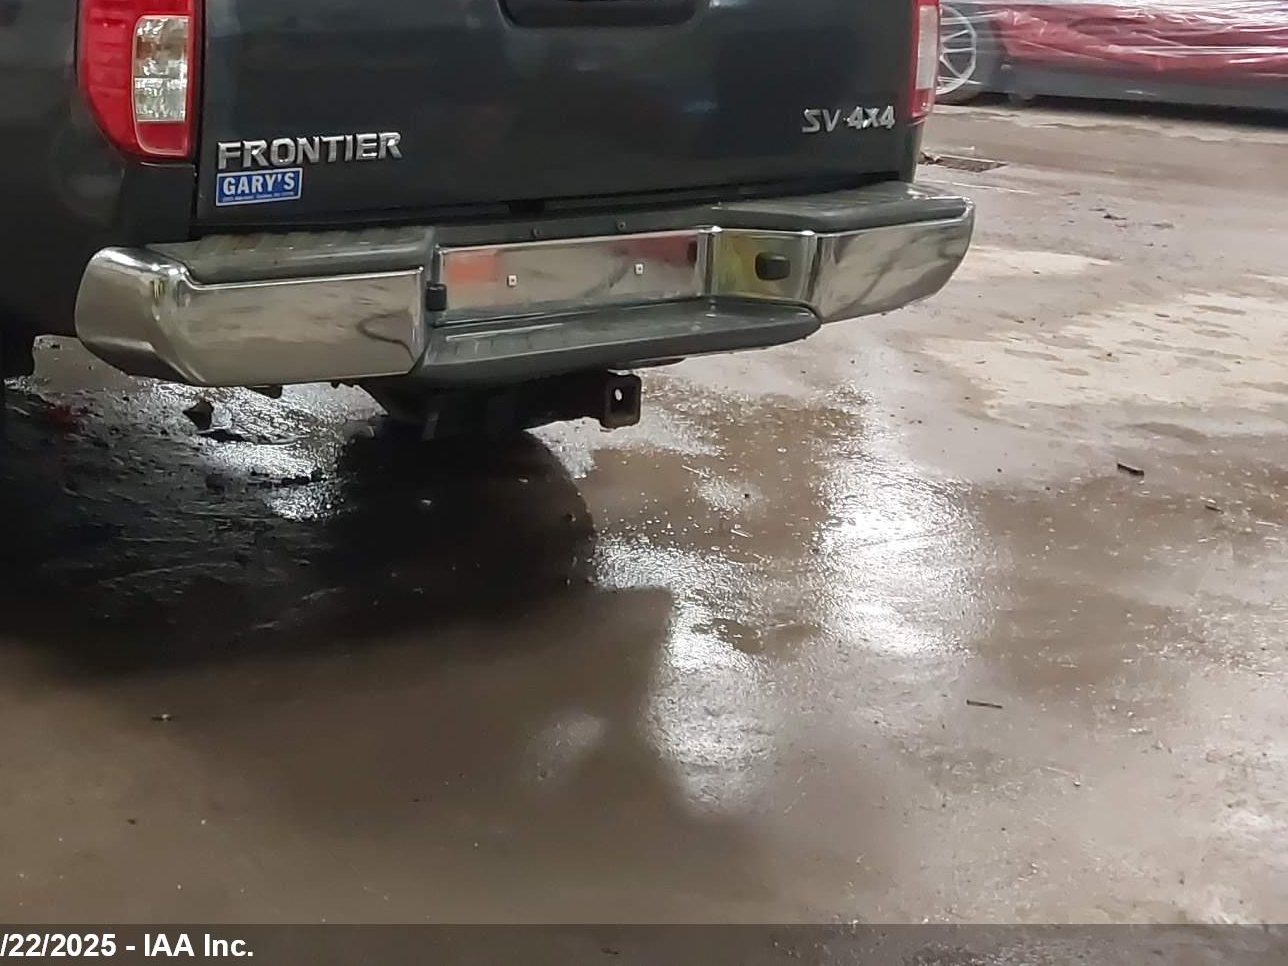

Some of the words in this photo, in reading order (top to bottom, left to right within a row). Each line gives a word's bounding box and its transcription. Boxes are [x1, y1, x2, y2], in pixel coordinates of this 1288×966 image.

[802, 108, 842, 133] SV
[218, 132, 402, 170] FRONTIER
[223, 172, 295, 197] GARY'S
